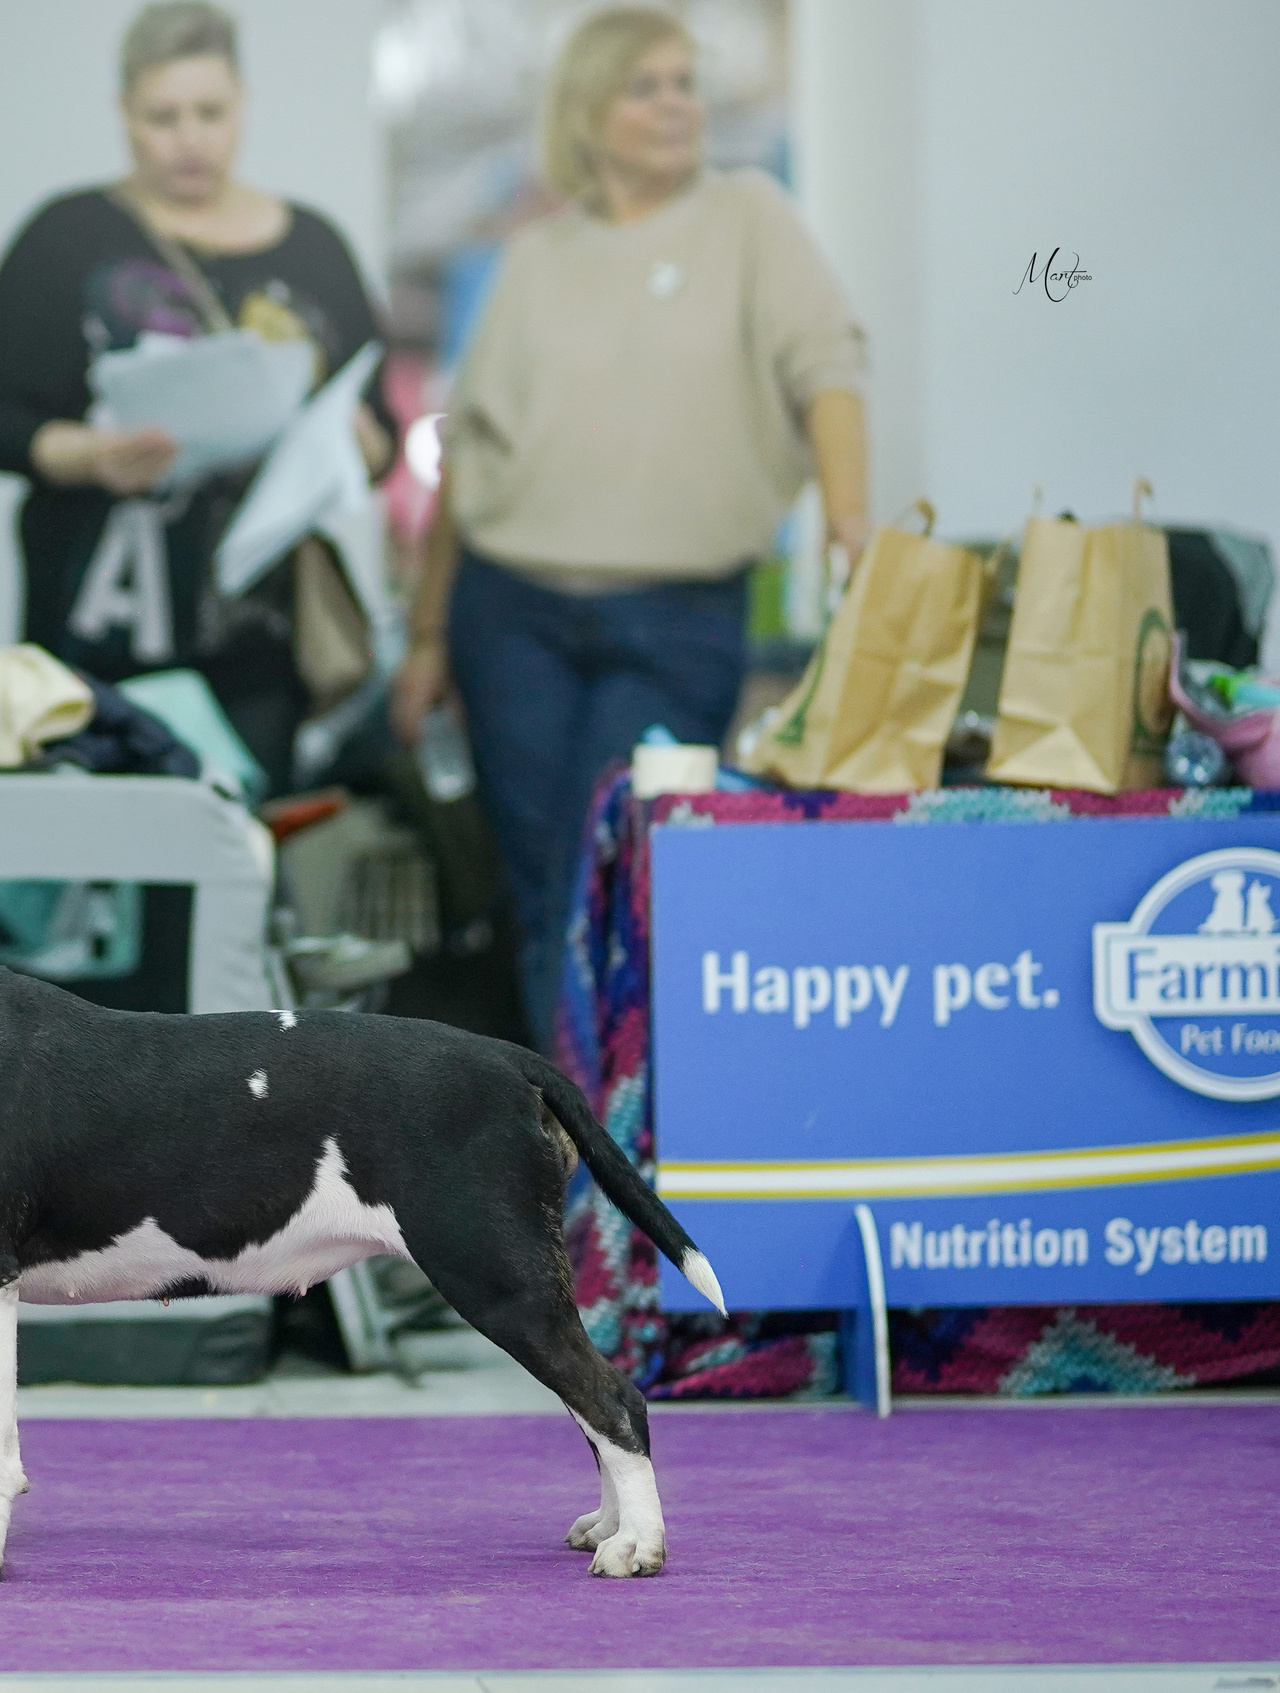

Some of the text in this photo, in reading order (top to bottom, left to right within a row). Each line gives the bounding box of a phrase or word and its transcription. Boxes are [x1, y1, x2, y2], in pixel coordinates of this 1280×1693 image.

[702, 949, 1060, 1028] Happy pet.
[1180, 1023, 1224, 1056] Pet
[889, 1216, 1268, 1275] Nutrition System
